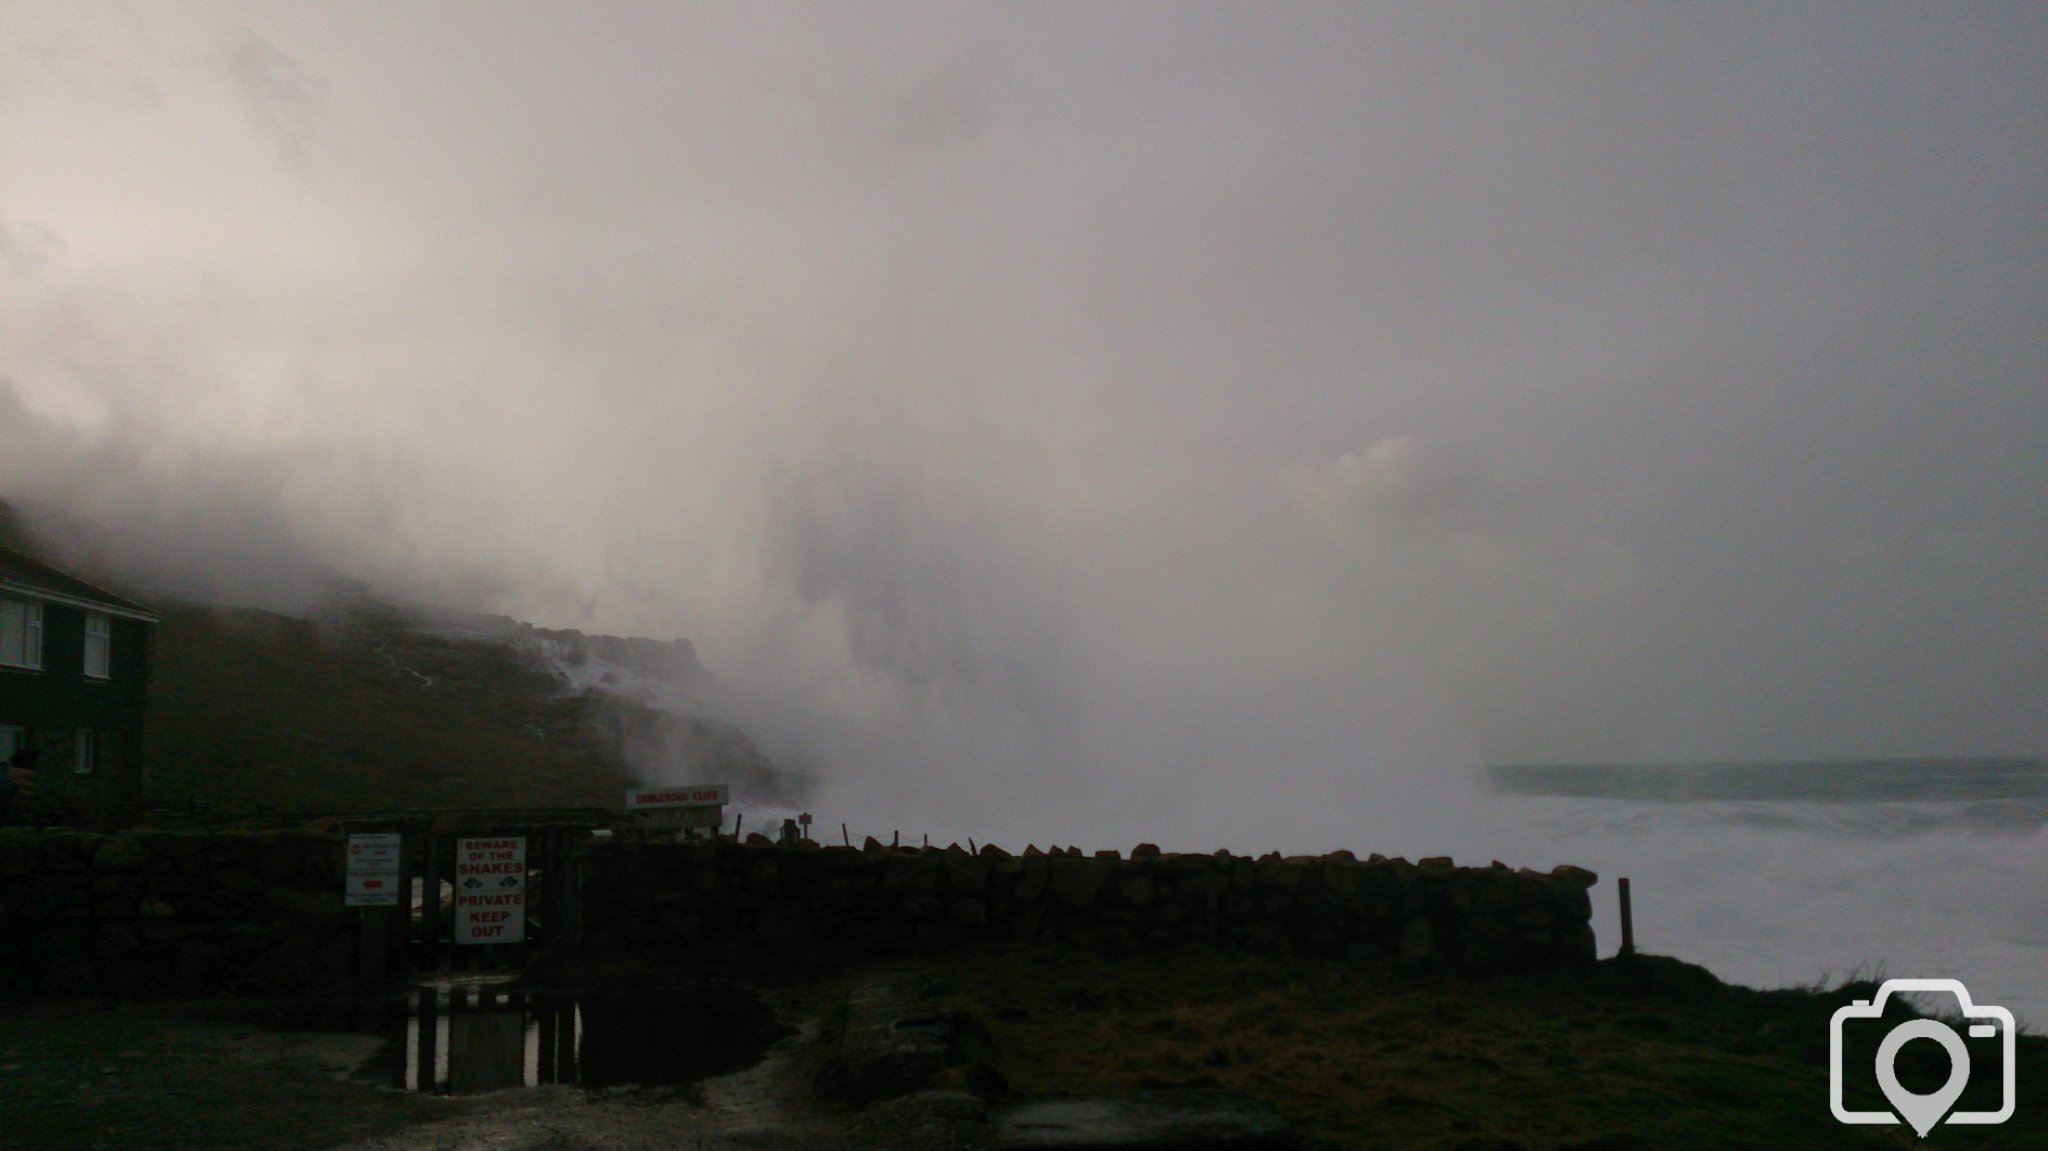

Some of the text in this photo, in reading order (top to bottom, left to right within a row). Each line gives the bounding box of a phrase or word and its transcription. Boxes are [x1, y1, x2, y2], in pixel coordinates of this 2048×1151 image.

[636, 790, 719, 804] DANGEROUS CLIFF
[465, 840, 518, 850] BEWARE
[469, 851, 513, 861] OF THE
[459, 863, 523, 875] SNAKES
[458, 894, 522, 906] PRIVATE
[470, 911, 510, 922] KEEP
[471, 926, 502, 937] OUT
